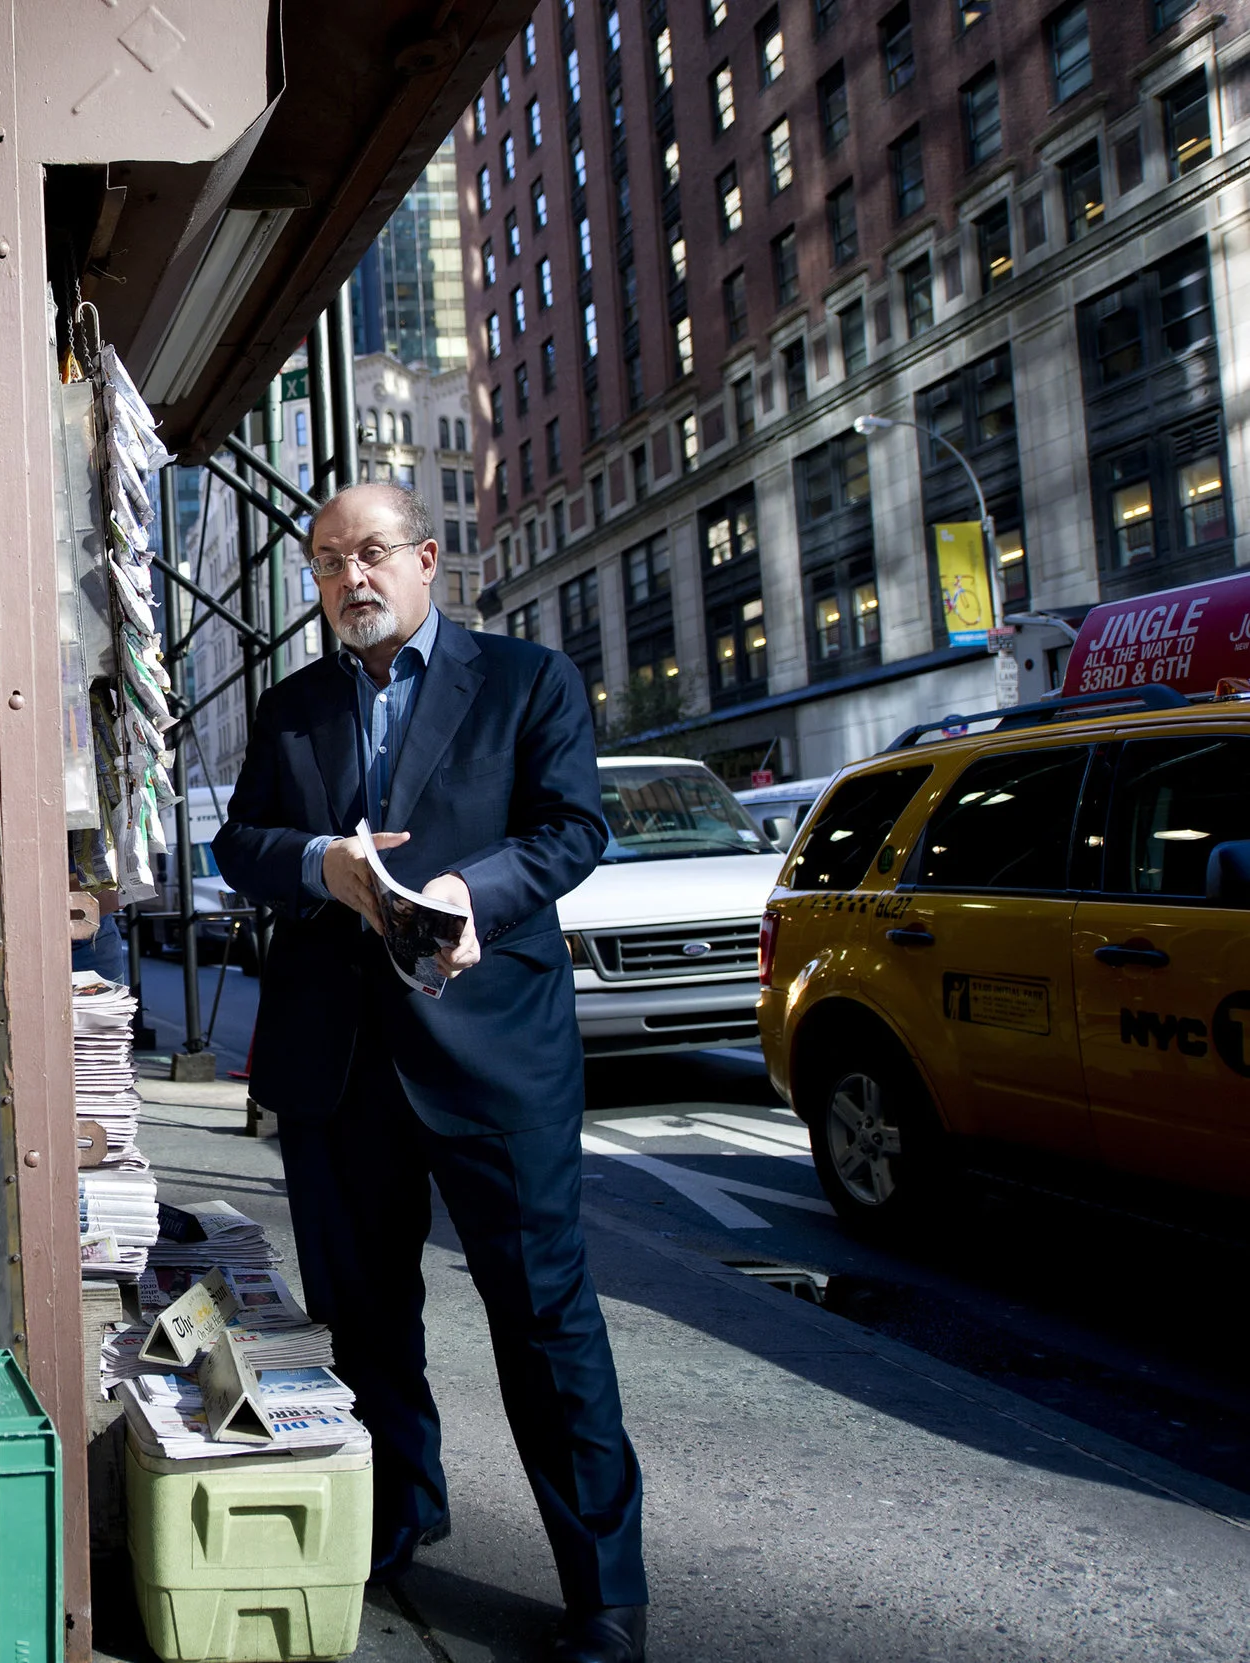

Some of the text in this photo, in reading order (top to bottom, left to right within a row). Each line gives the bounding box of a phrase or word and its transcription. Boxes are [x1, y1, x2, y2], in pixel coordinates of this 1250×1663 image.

[1089, 597, 1211, 651] JINGLE
[1083, 635, 1196, 670] ALL THE WAY TO
[1079, 654, 1192, 692] 33RD & 6TH
[1120, 1008, 1208, 1058] NYC
[172, 1315, 194, 1339] The
